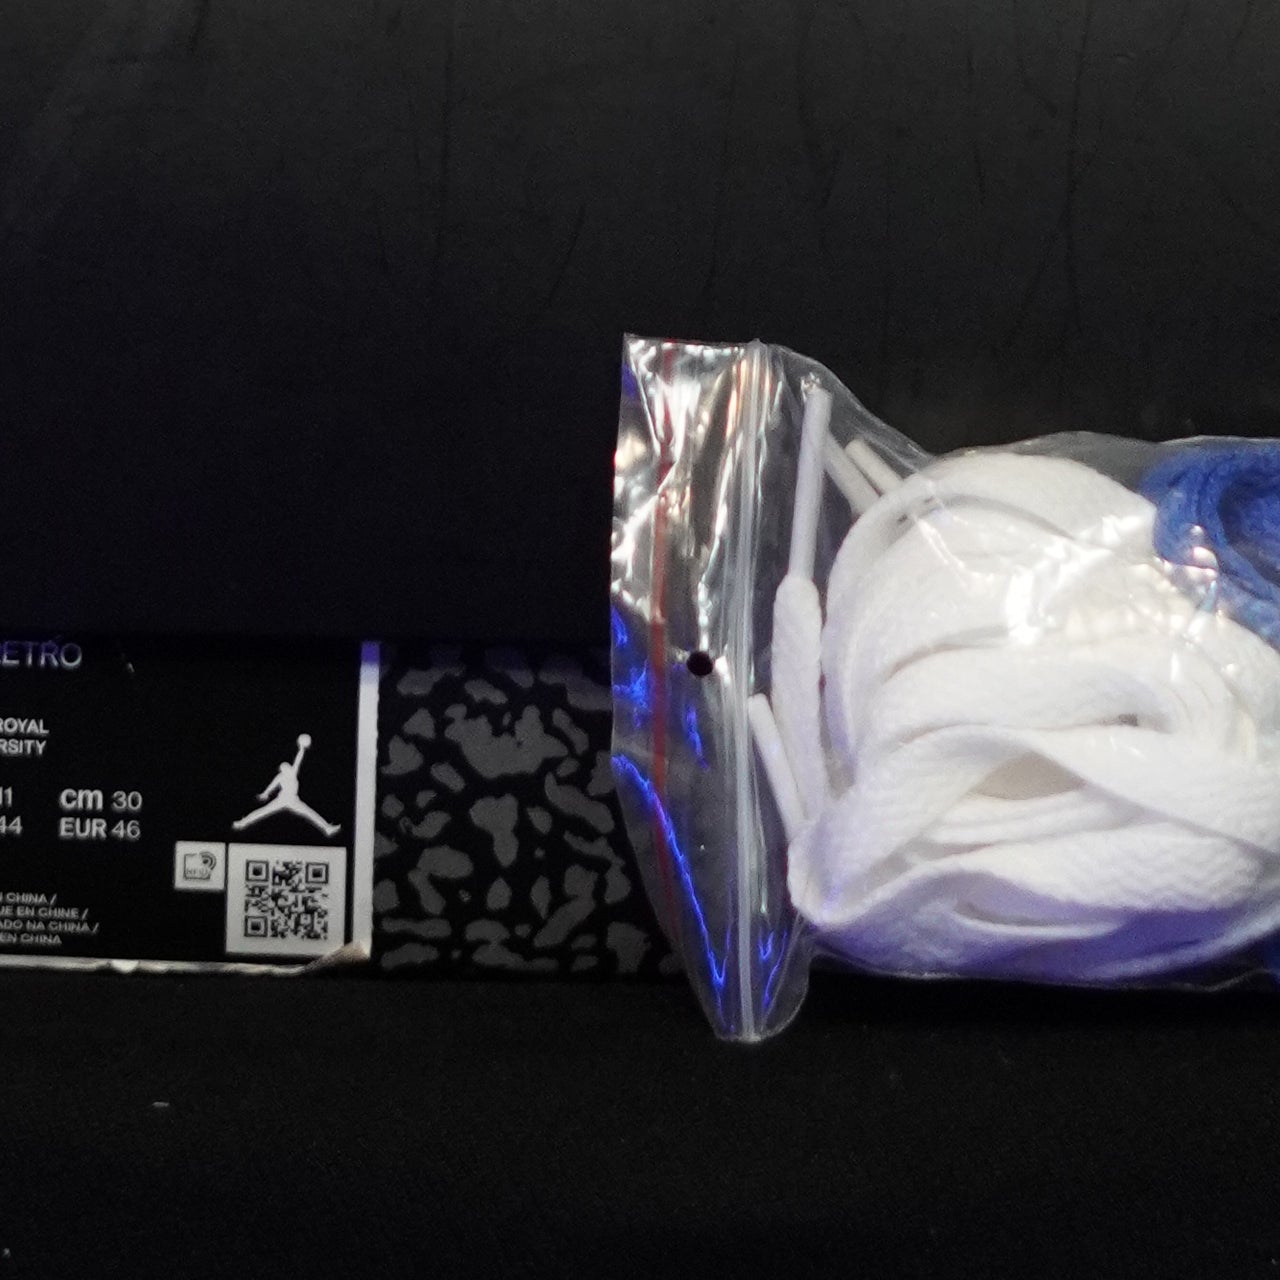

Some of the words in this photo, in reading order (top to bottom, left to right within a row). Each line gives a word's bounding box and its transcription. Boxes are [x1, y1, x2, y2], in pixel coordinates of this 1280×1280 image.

[59, 788, 104, 811] cm
[112, 790, 142, 811] 30
[59, 817, 107, 839] EUR
[111, 819, 141, 839] 46
[17, 905, 34, 917] EN
